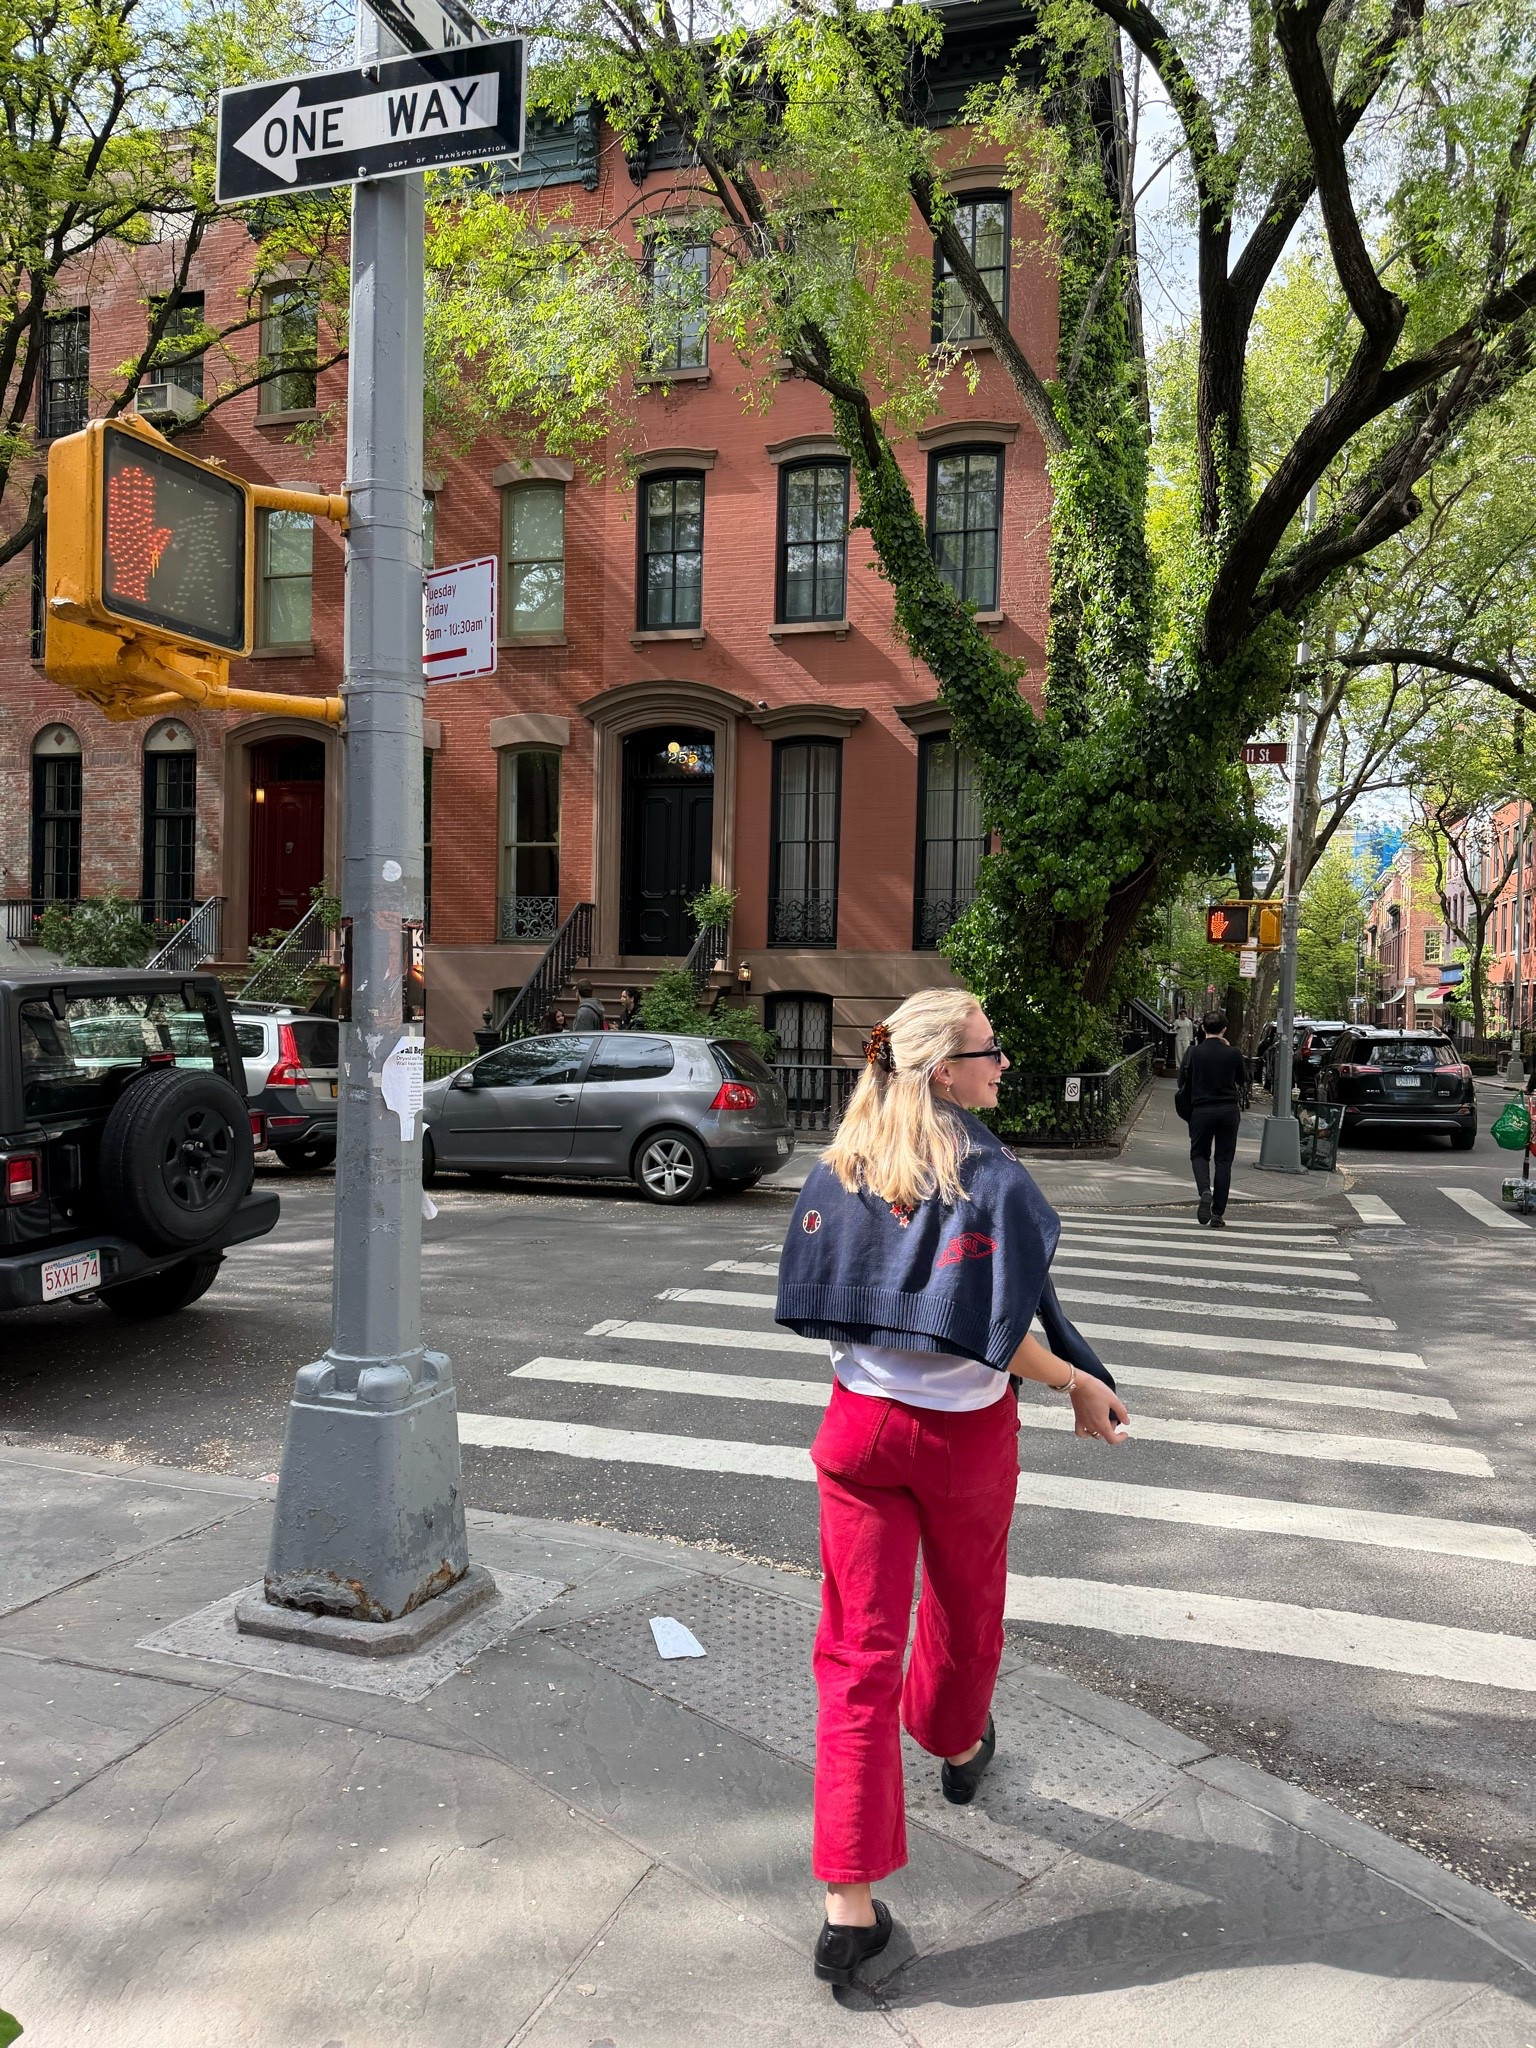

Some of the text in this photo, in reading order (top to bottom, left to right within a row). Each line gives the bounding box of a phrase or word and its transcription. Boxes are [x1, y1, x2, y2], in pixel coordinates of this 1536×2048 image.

[264, 81, 480, 158] ONE WAY
[388, 160, 408, 168] DEPT
[434, 145, 507, 161] TRANSPORTATION
[425, 584, 457, 601] Tuesday
[425, 602, 449, 618] Friday
[425, 627, 442, 641] 9am
[449, 618, 483, 636] 10:30am
[668, 751, 698, 764] 255
[1246, 748, 1270, 762] 11 St
[45, 1264, 79, 1291] 5XXH
[82, 1259, 98, 1281] 74
